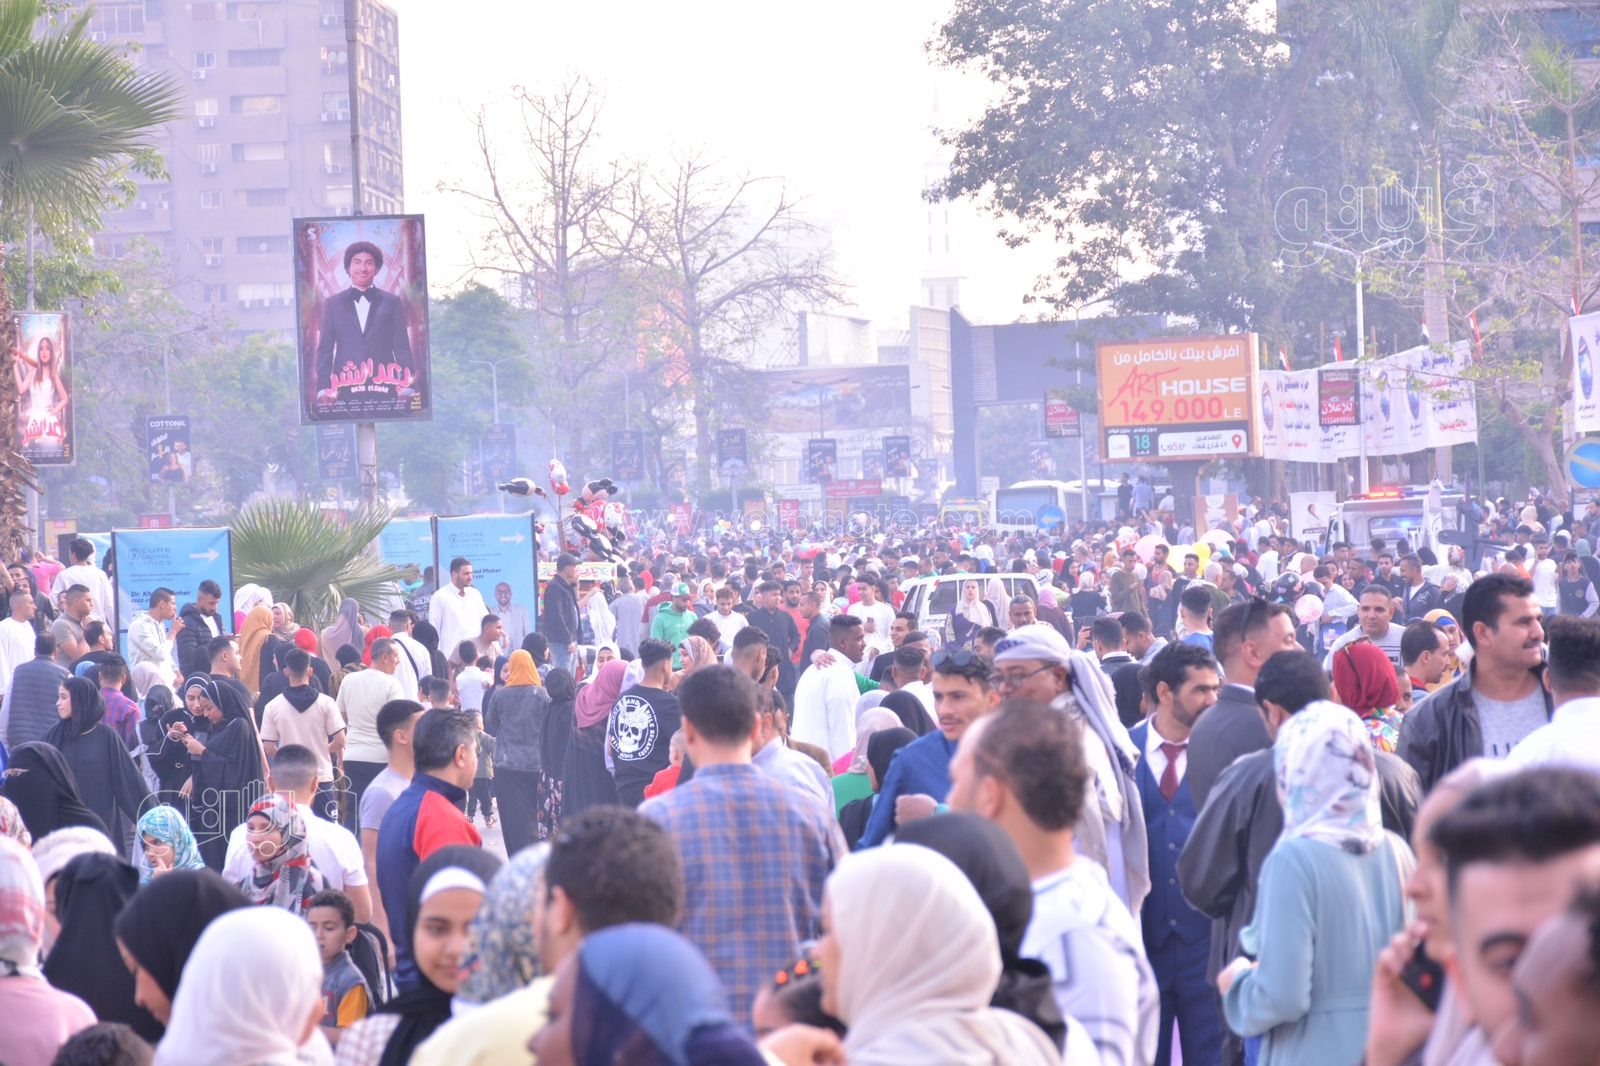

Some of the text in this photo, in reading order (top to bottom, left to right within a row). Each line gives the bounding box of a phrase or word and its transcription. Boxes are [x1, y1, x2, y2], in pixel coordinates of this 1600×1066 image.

[1113, 352, 1131, 366] من
[1133, 349, 1178, 364] بالكامل
[1179, 348, 1205, 361] بيتك
[1107, 366, 1181, 408] ART
[1161, 376, 1247, 396] HOUSE
[1119, 396, 1224, 423] 149.000
[150, 420, 187, 428] COTTONIL
[1133, 434, 1151, 449] 18
